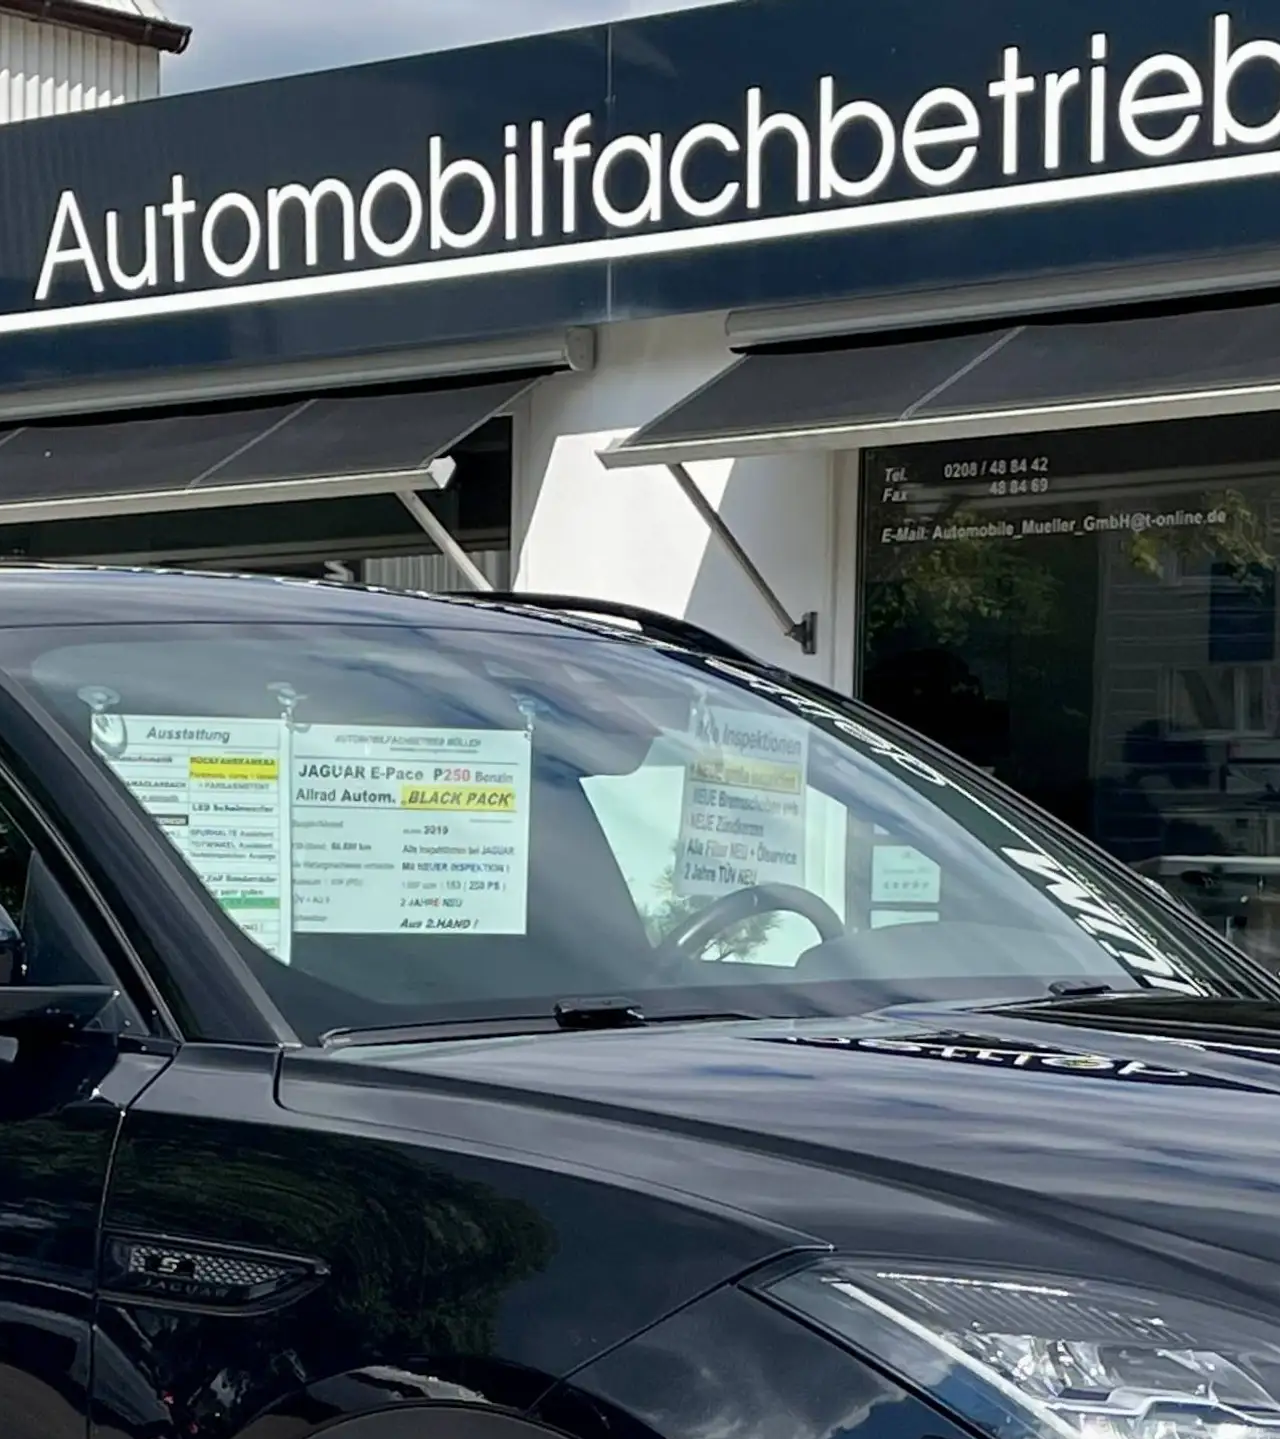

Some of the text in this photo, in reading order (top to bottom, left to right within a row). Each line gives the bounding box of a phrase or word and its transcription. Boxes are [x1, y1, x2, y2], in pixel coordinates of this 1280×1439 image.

[885, 467, 908, 482] Tel.
[944, 462, 977, 478] 0208
[1010, 458, 1027, 473] 84
[1031, 457, 1049, 472] 42
[883, 487, 908, 502] Fax
[881, 526, 928, 543] E-Mail:
[146, 727, 231, 744] Ausstattung
[298, 764, 514, 783] JAGUAR E-Pace P250 Benzin
[296, 788, 337, 802] Allrad
[341, 789, 396, 804] Autom.
